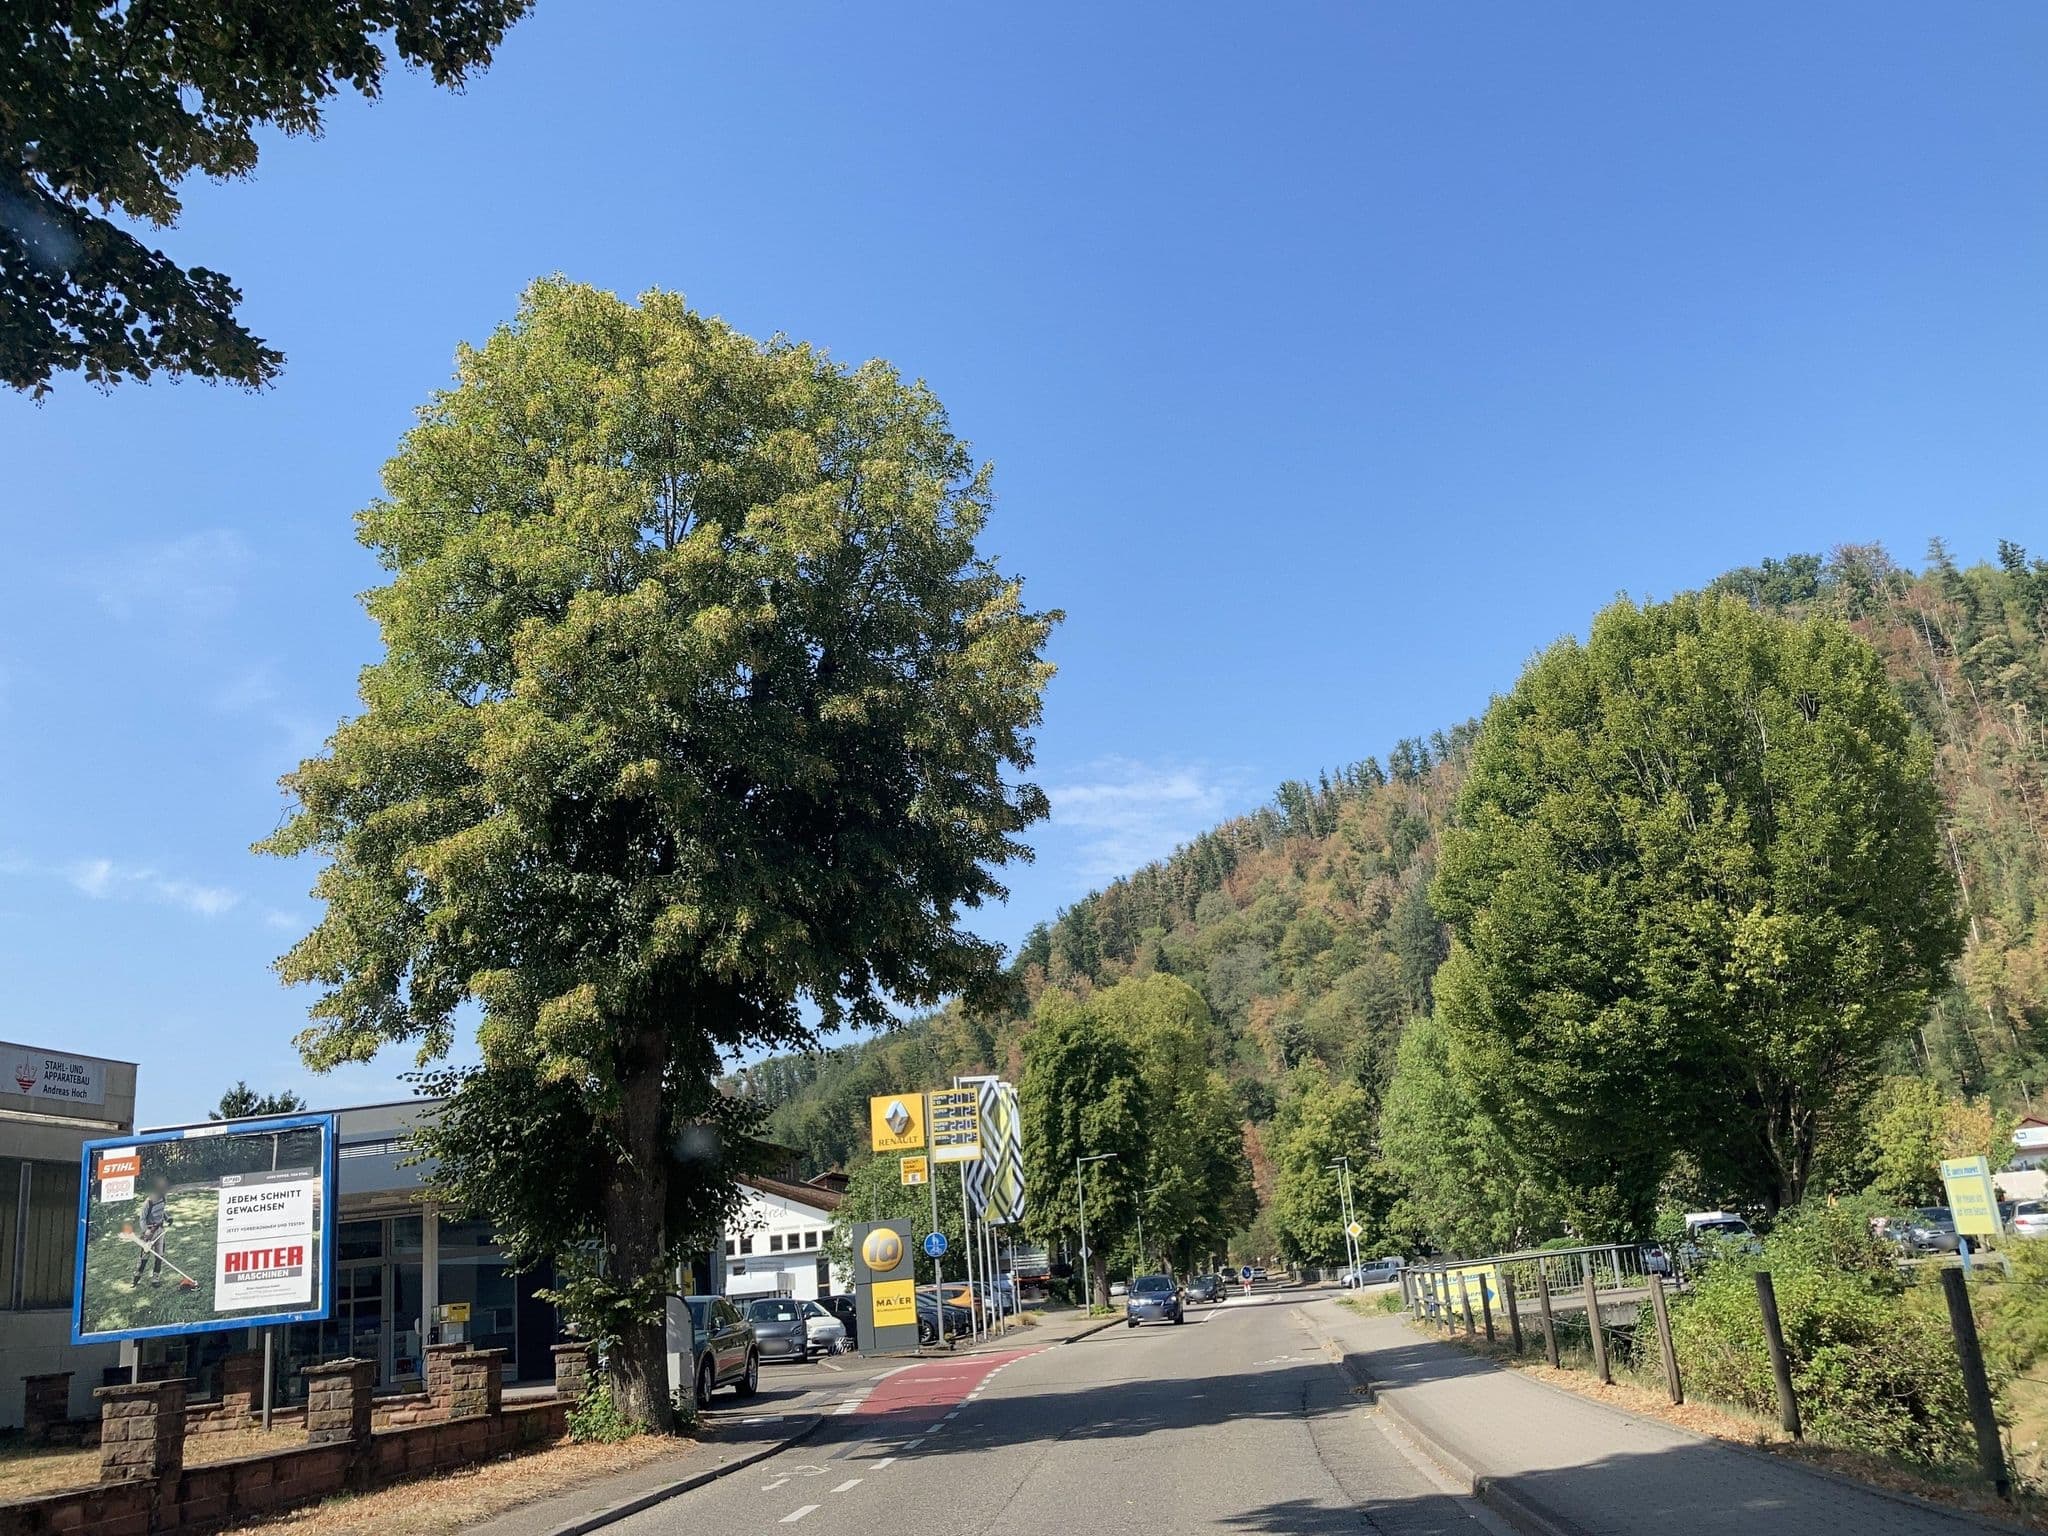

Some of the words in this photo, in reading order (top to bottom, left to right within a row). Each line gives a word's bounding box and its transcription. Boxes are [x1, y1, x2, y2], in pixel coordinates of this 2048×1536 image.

[45, 1060, 68, 1072] STAHL-
[69, 1064, 84, 1075] UND
[44, 1071, 90, 1086] APPARATEBAU
[43, 1084, 70, 1097] Andreas
[71, 1088, 88, 1099] Hoch
[878, 1136, 918, 1146] RENAULT
[103, 1162, 135, 1174] STIHL
[227, 1194, 257, 1204] JEDEM
[260, 1189, 302, 1201] SCHNITT
[226, 1202, 285, 1215] GEWACHSEN
[225, 1245, 303, 1272] RITTER
[237, 1269, 289, 1281] MASCHINEN
[876, 1296, 912, 1307] MAYER
